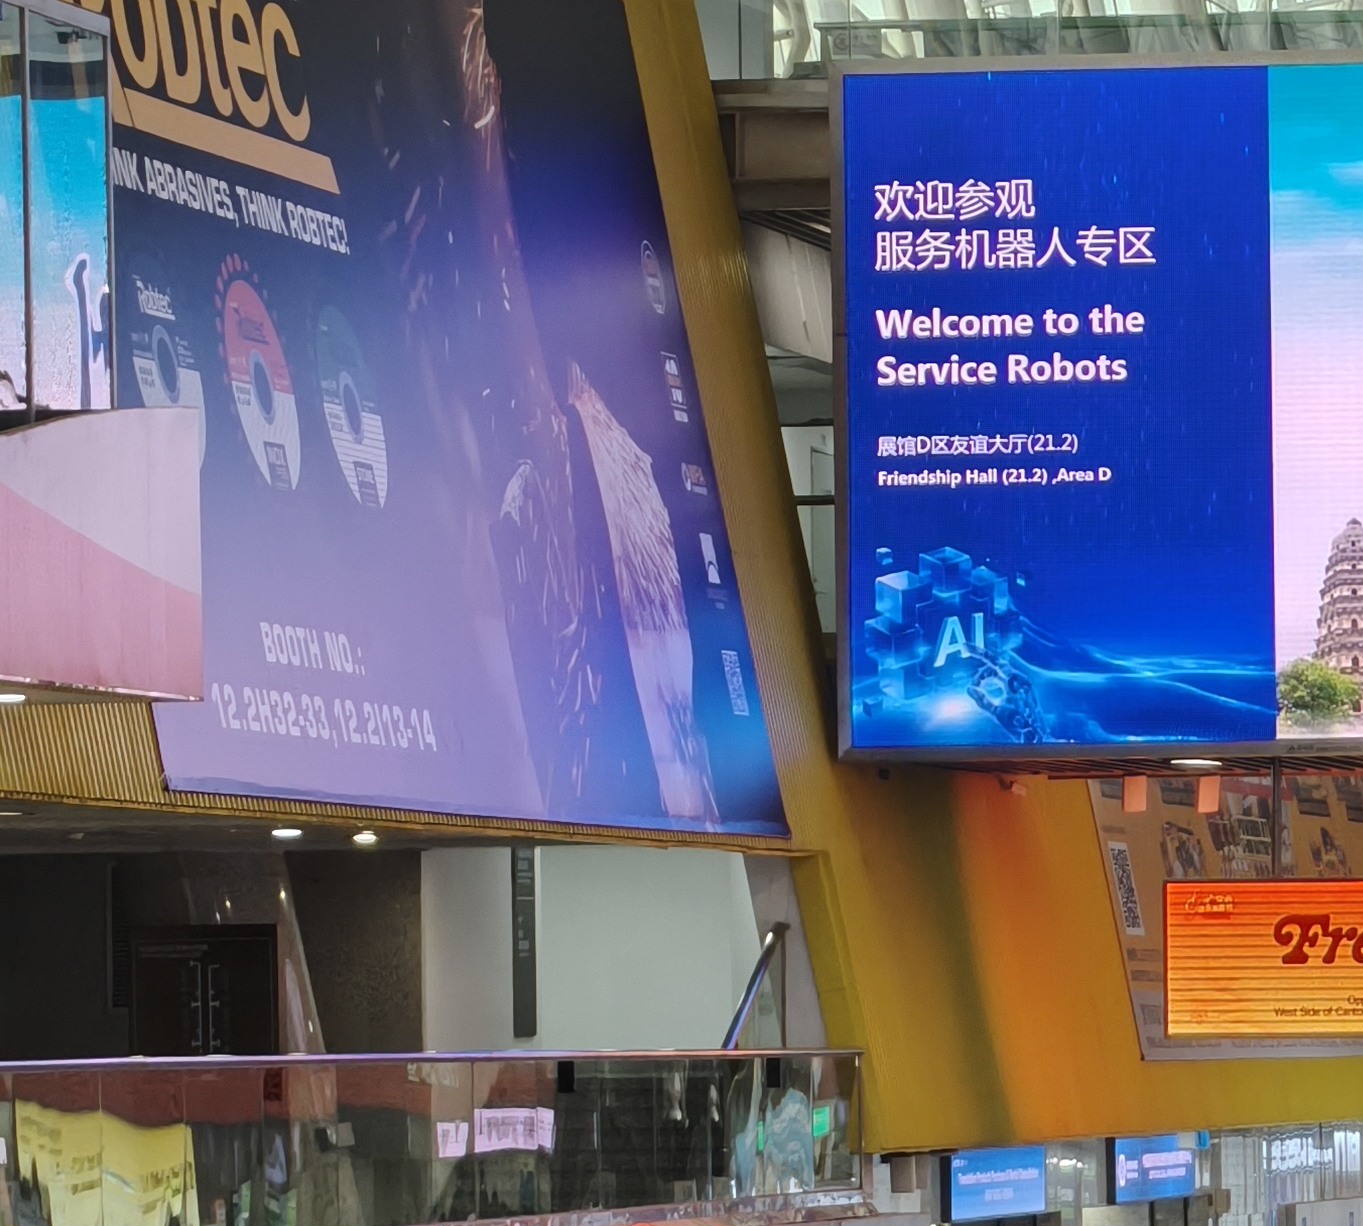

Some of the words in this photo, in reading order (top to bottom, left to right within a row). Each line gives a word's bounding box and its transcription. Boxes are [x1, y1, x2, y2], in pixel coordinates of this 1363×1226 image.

[144, 156, 239, 228] ABRASIVES,
[236, 185, 289, 237] THINK
[286, 201, 350, 255] ROBTEC!
[874, 178, 1036, 222] 欢迎参观
[874, 225, 1157, 271] 服务机器人专区
[876, 307, 1034, 339] Welcome
[1043, 308, 1079, 334] to
[1089, 304, 1144, 333] the
[877, 354, 997, 385] Service
[1007, 352, 1127, 383] Robots
[877, 434, 1078, 456] 展馆D区友谊大厅(21.2)
[878, 469, 961, 488] Friendship
[966, 468, 997, 484] Hall
[1002, 468, 1047, 484] (21.2)
[1098, 467, 1111, 480] D
[260, 622, 323, 669] BOOTH
[933, 612, 985, 668] AI
[1273, 1007, 1297, 1016] West
[1300, 1006, 1320, 1016] Side
